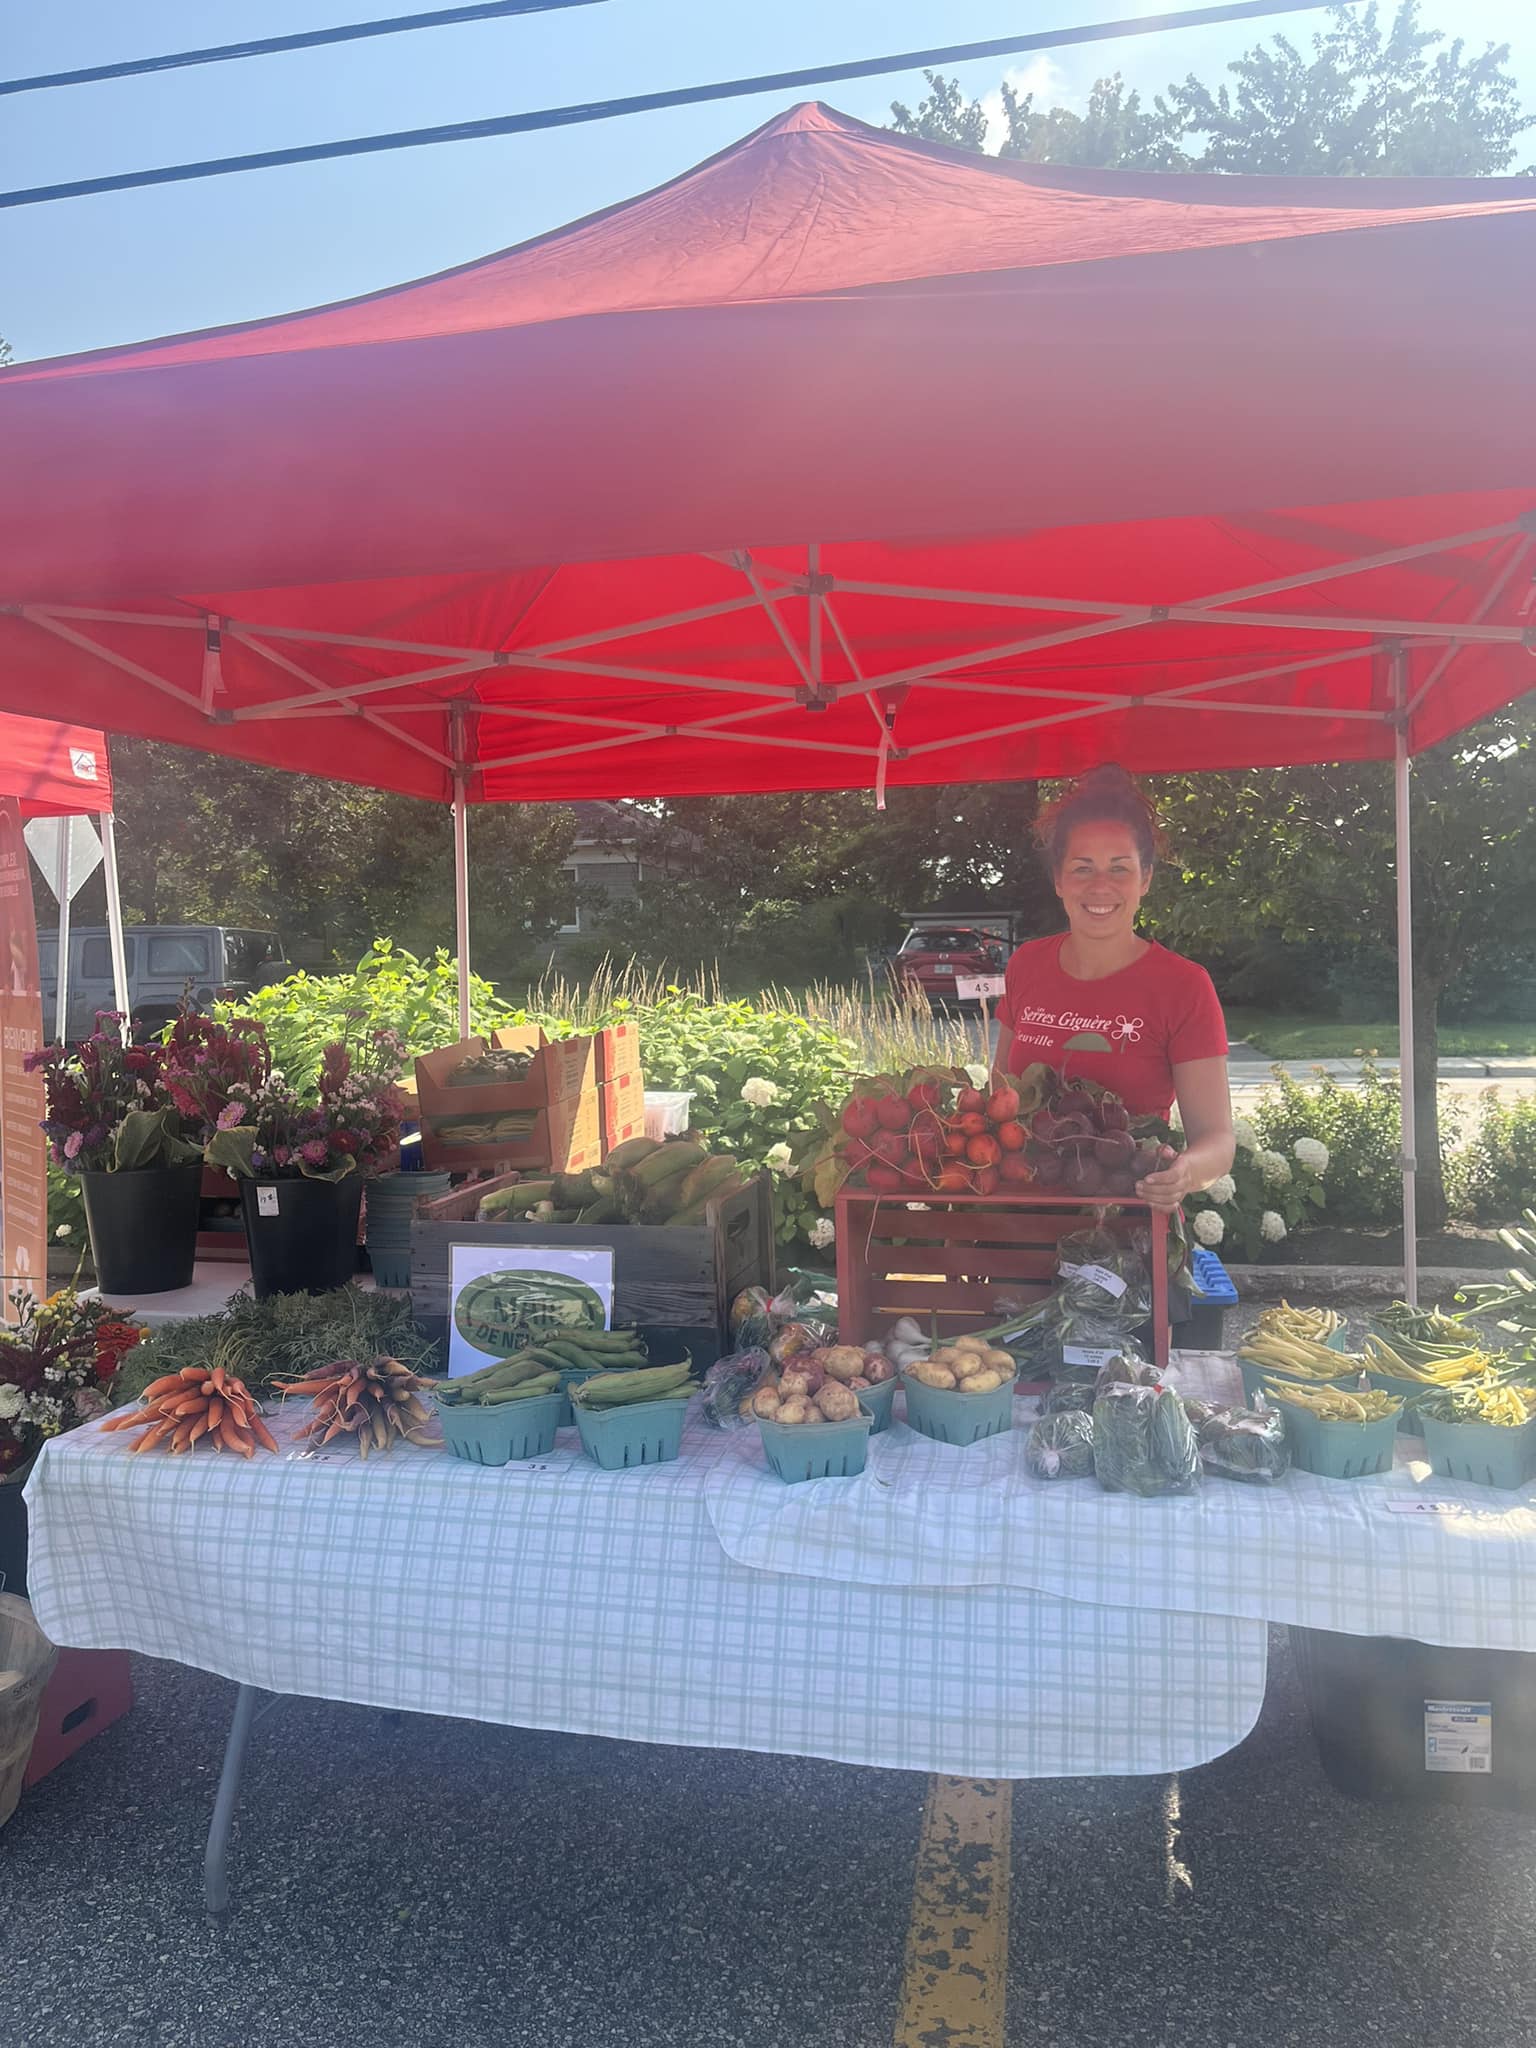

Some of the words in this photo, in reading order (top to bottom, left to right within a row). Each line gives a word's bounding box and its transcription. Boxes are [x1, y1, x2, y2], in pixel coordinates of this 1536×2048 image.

[1021, 1006, 1056, 1024] Serres
[1058, 1011, 1112, 1031] Giguère
[1017, 1029, 1054, 1047] euville
